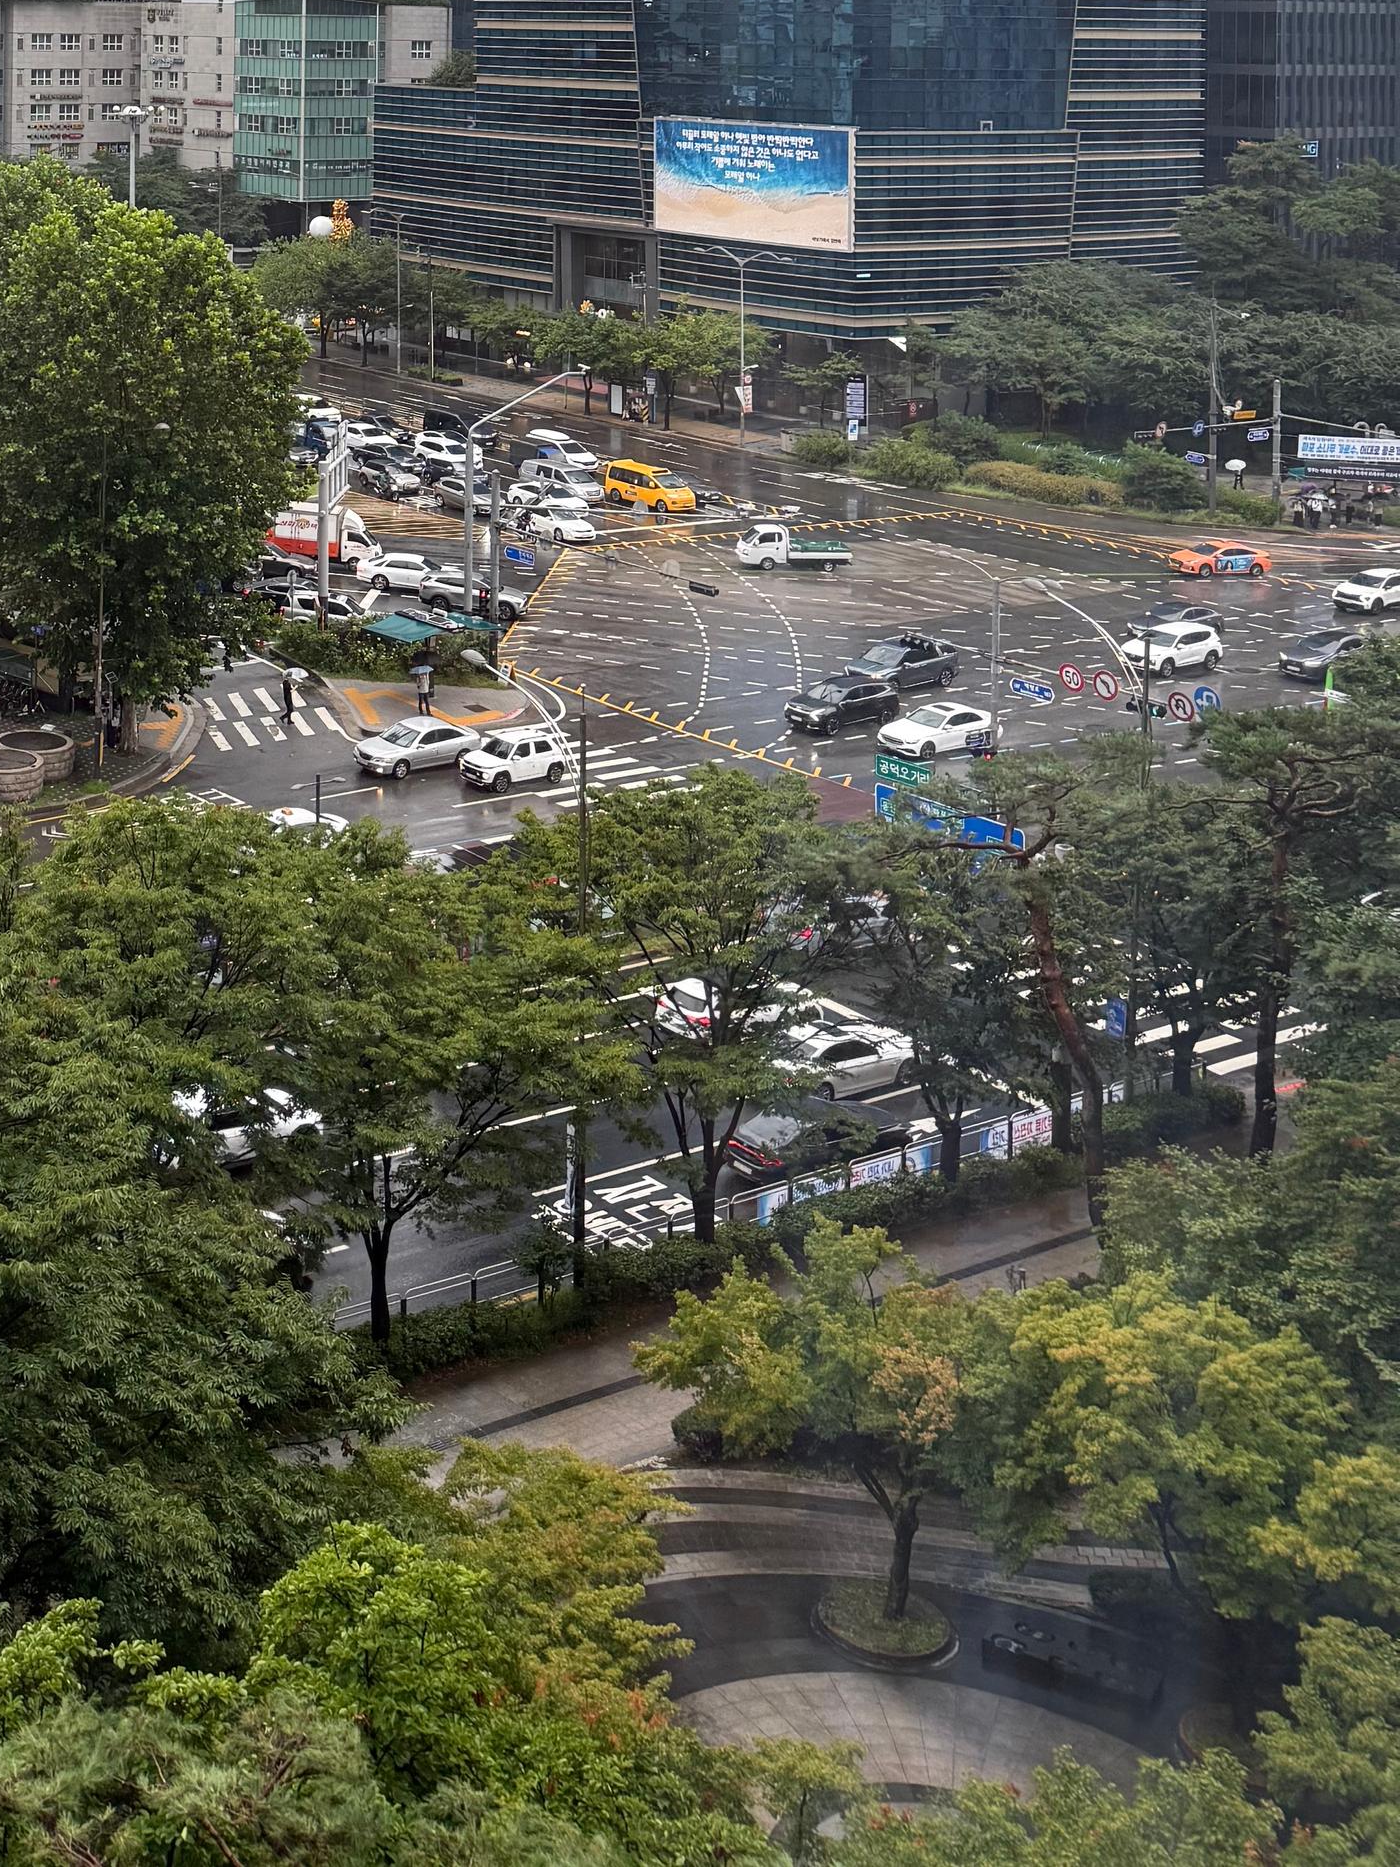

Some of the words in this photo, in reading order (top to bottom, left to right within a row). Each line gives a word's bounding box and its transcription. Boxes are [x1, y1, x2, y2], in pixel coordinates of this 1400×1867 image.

[713, 144, 740, 156] 소중하지
[755, 147, 771, 159] 것은
[771, 148, 795, 159] 하나도
[795, 150, 819, 162] 없다고
[1064, 670, 1079, 687] 50
[879, 759, 930, 784] 공덕오거리
